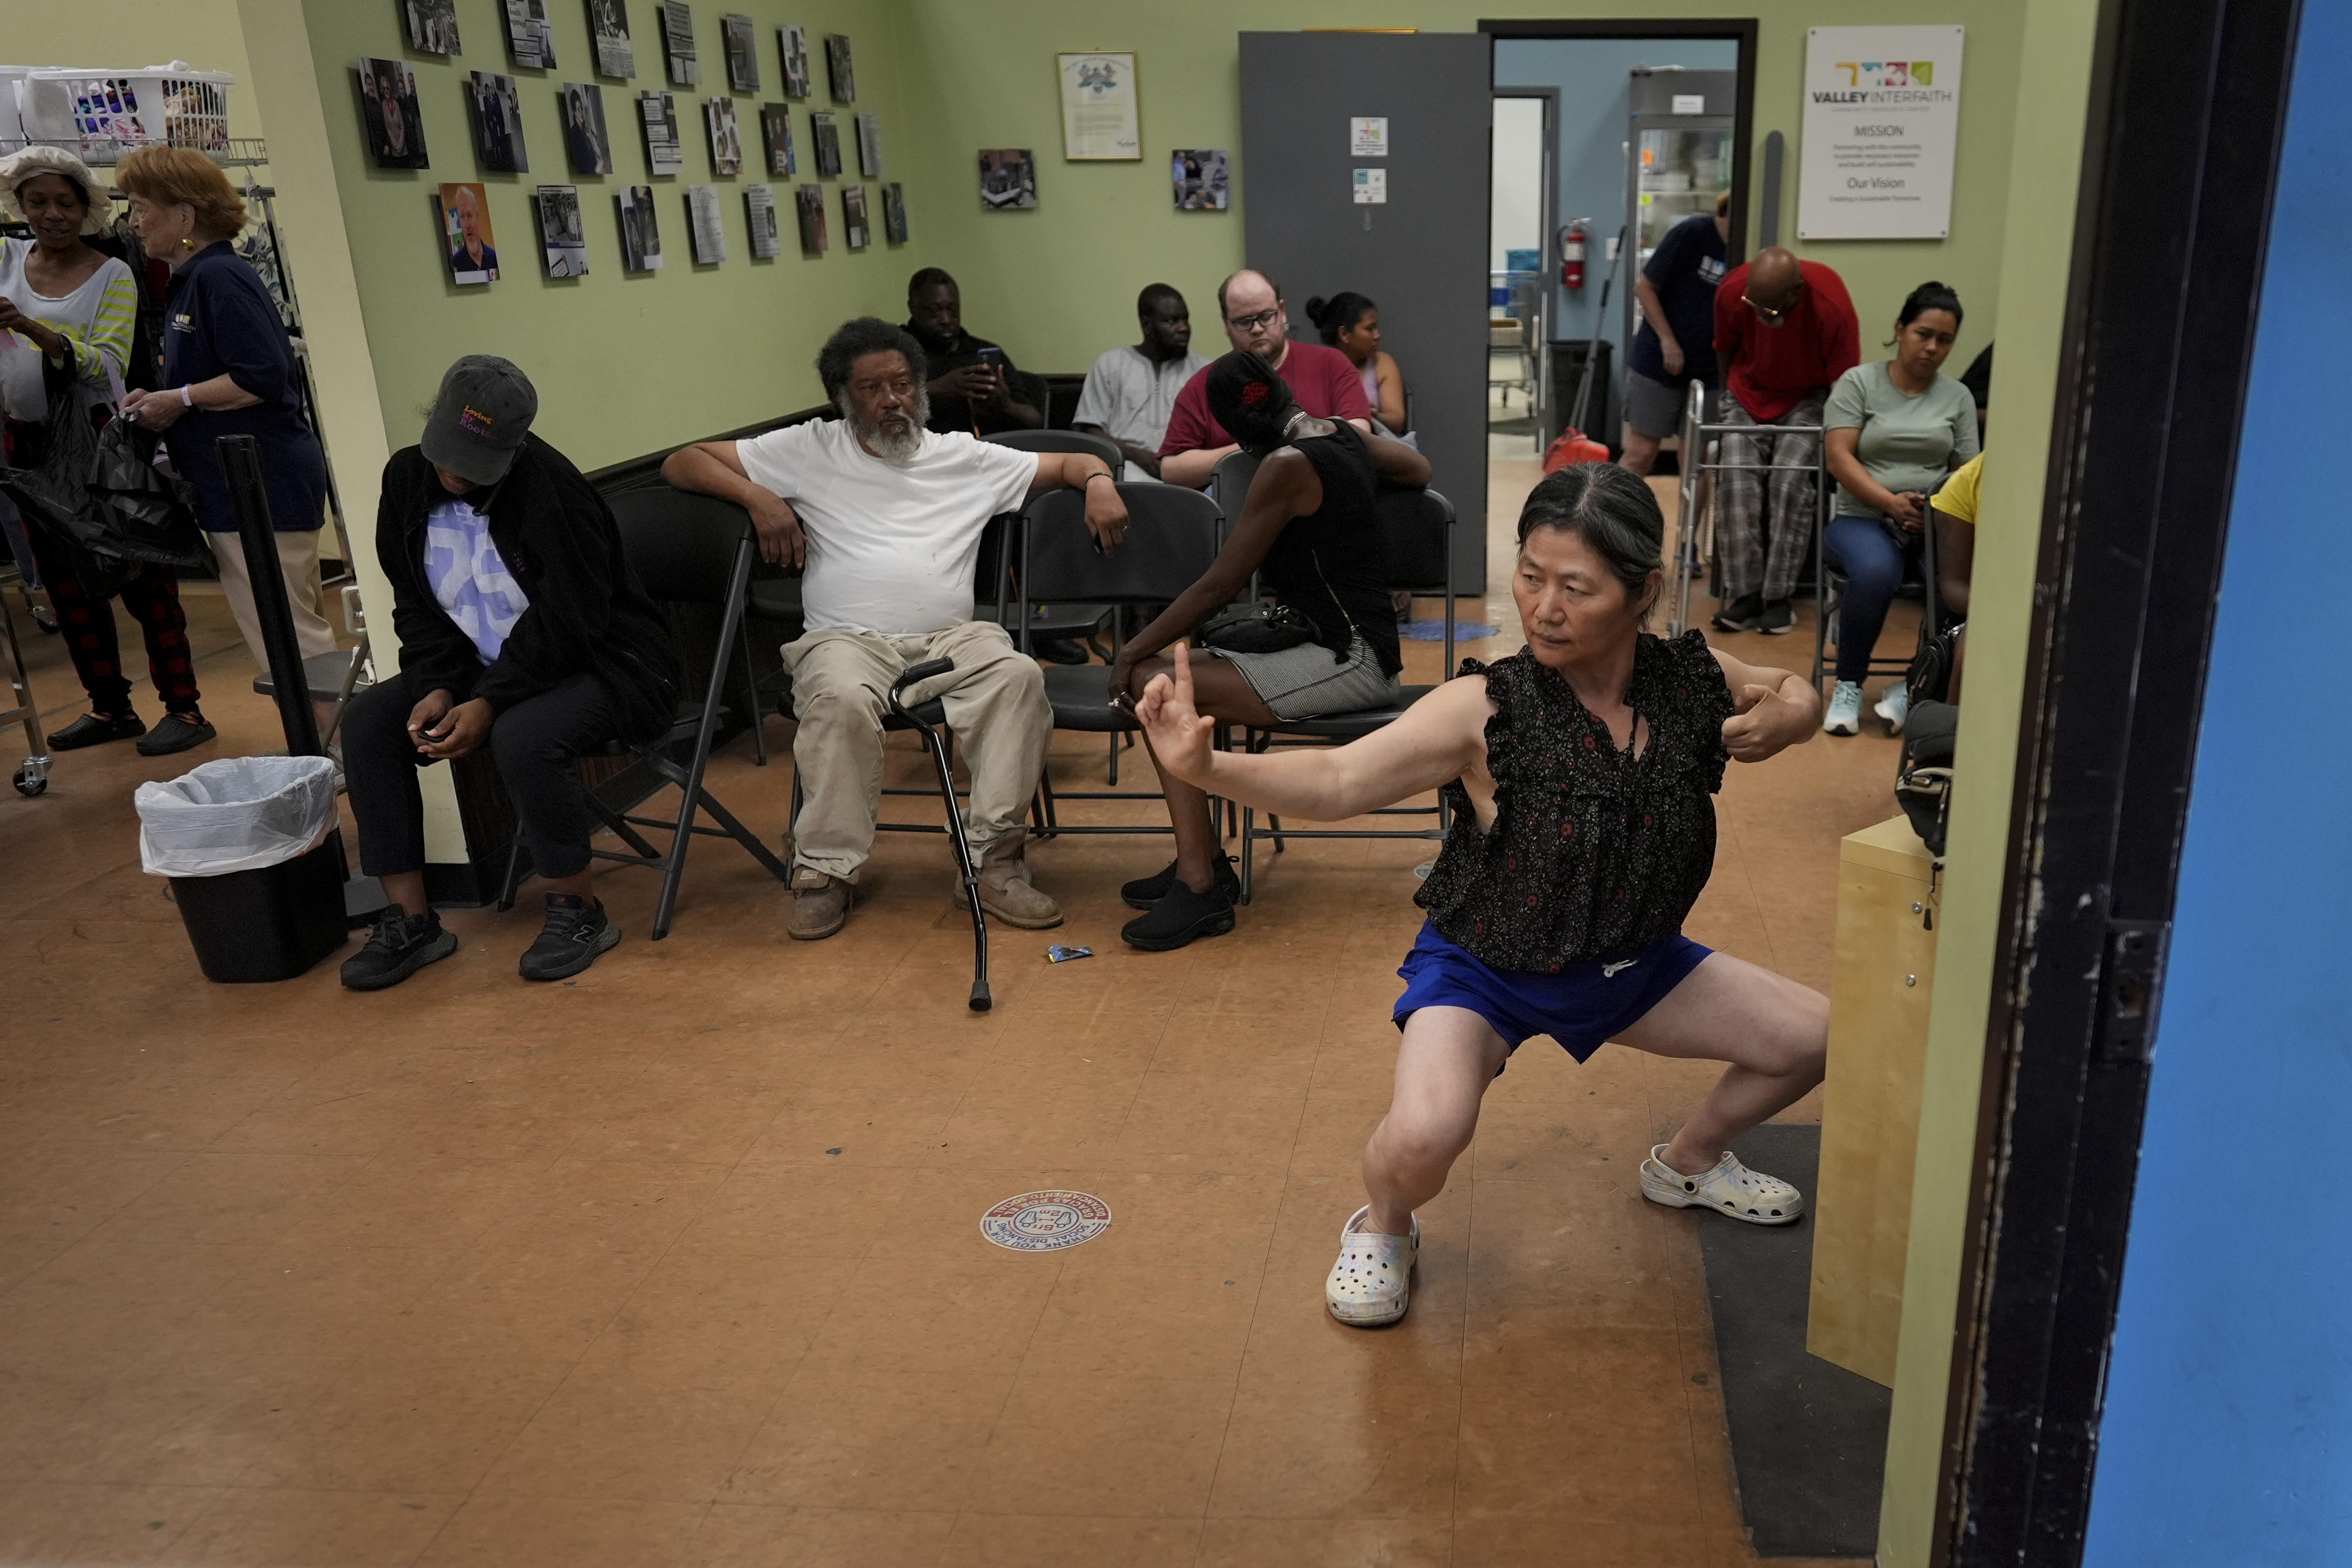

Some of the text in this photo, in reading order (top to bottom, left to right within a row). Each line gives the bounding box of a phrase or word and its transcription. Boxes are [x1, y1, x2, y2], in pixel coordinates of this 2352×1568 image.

[1812, 90, 1952, 103] VALLEY INTERFAITH
[1854, 125, 1904, 136] MISSION
[1847, 177, 1905, 188] Our Vision
[461, 410, 476, 422] My
[464, 404, 492, 424] Loving
[993, 1192, 1106, 1217] DISTANCIAMIENTO SOCIAL
[1020, 1199, 1048, 1207] POR
[1053, 1198, 1094, 1217] GRACIAS
[991, 1231, 1010, 1243] FOR
[997, 1223, 1089, 1243] SOCIAL DISTANCING
[1045, 1234, 1088, 1248] THANK
